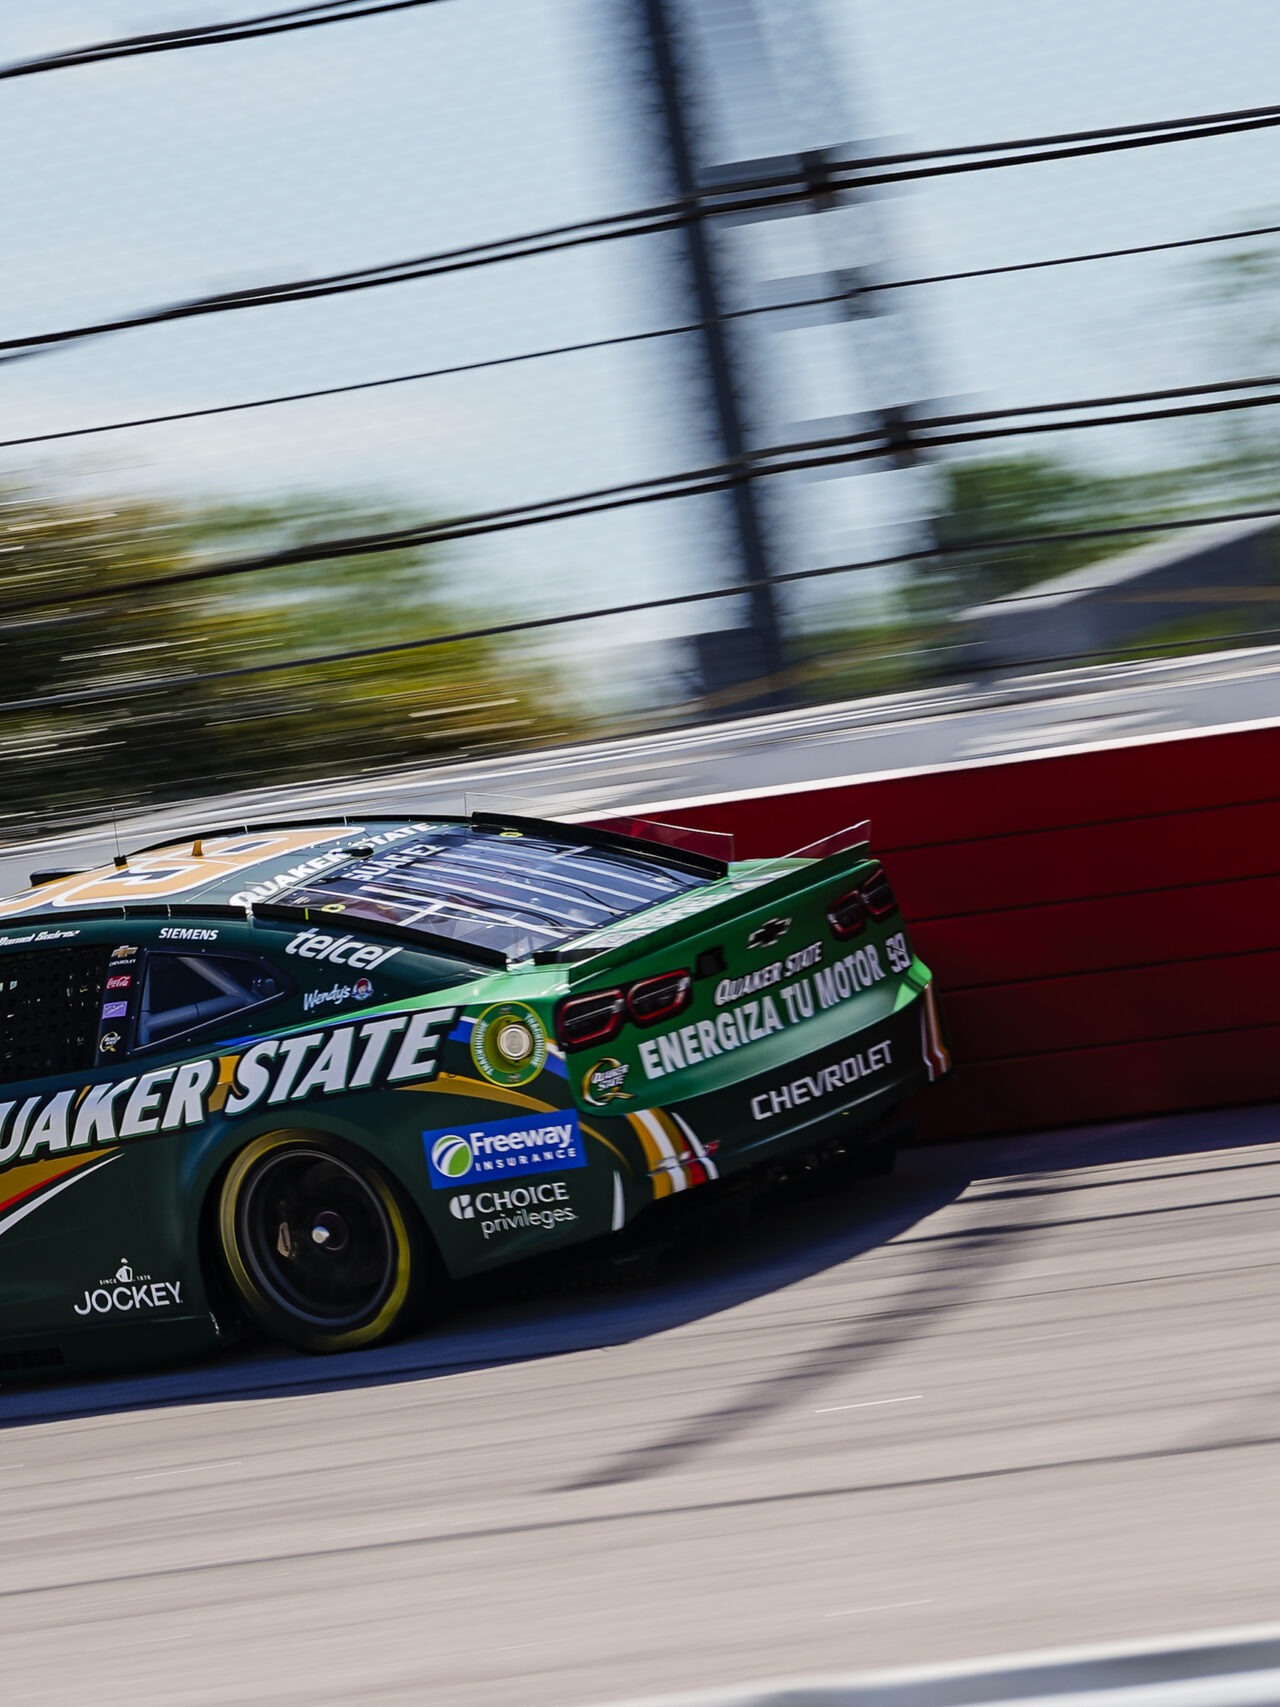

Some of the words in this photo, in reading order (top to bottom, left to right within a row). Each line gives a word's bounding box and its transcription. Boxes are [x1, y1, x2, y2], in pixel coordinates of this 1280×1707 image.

[229, 847, 352, 908] QUAKER
[350, 823, 436, 850] STATE
[158, 927, 219, 942] SIEMENS
[285, 928, 404, 970] telcel
[885, 932, 911, 973] 99
[714, 962, 783, 1005] QUAKER
[784, 941, 823, 977] STATE
[304, 984, 351, 1011] Wendy's
[638, 996, 784, 1079] ENERGIZA
[780, 979, 815, 1023] TU
[814, 945, 886, 1008] MOTOR
[226, 1007, 457, 1115] STATE
[750, 1040, 891, 1120] CHEVROLET
[469, 1124, 572, 1156] Freeway
[475, 1148, 577, 1172] INSURANCE
[475, 1182, 570, 1213] CHOICE
[481, 1207, 575, 1239] privileges
[74, 1281, 180, 1315] JOCKEY
